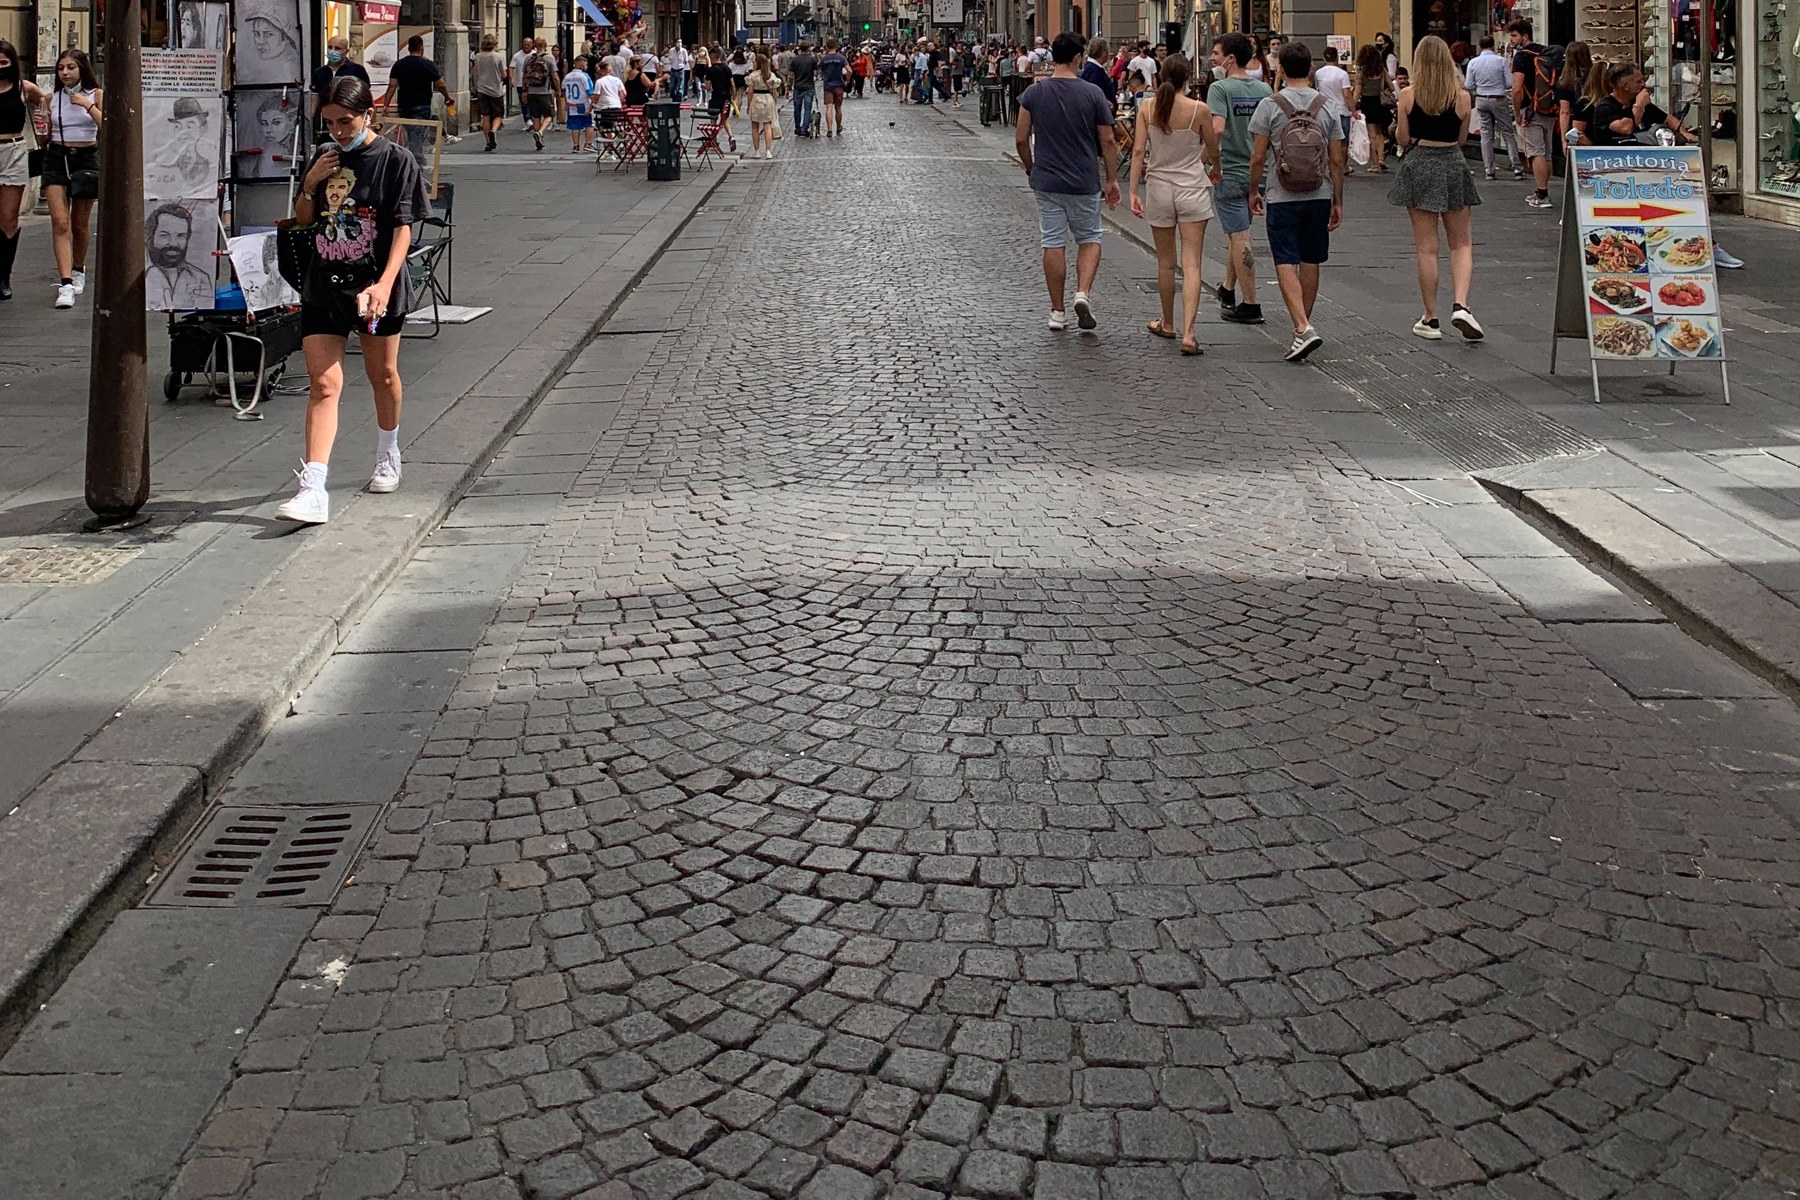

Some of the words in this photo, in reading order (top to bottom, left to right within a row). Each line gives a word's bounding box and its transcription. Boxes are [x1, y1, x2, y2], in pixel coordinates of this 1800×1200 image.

[566, 83, 580, 100] 10
[1586, 154, 1690, 173] Trattoria
[1588, 176, 1694, 200] Toledo
